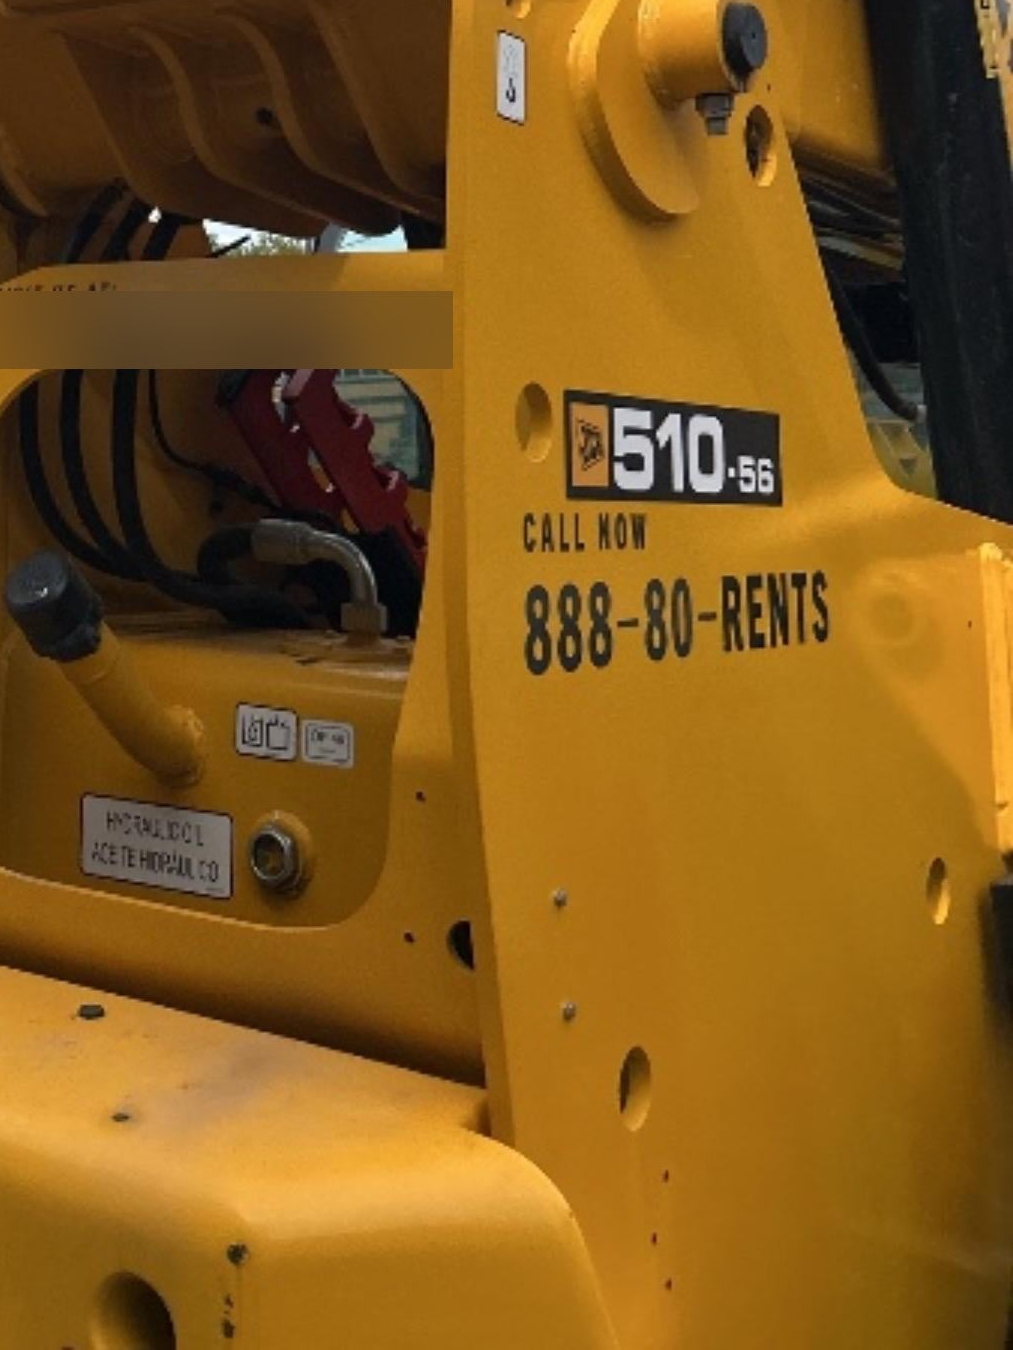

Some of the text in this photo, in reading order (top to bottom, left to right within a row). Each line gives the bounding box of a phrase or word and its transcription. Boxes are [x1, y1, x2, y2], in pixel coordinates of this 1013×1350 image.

[523, 513, 647, 552] CALL NOW
[524, 570, 829, 676] 888-80-RENTS
[182, 822, 205, 847] OL
[91, 842, 220, 884] ACETE HIDRÁULCO
